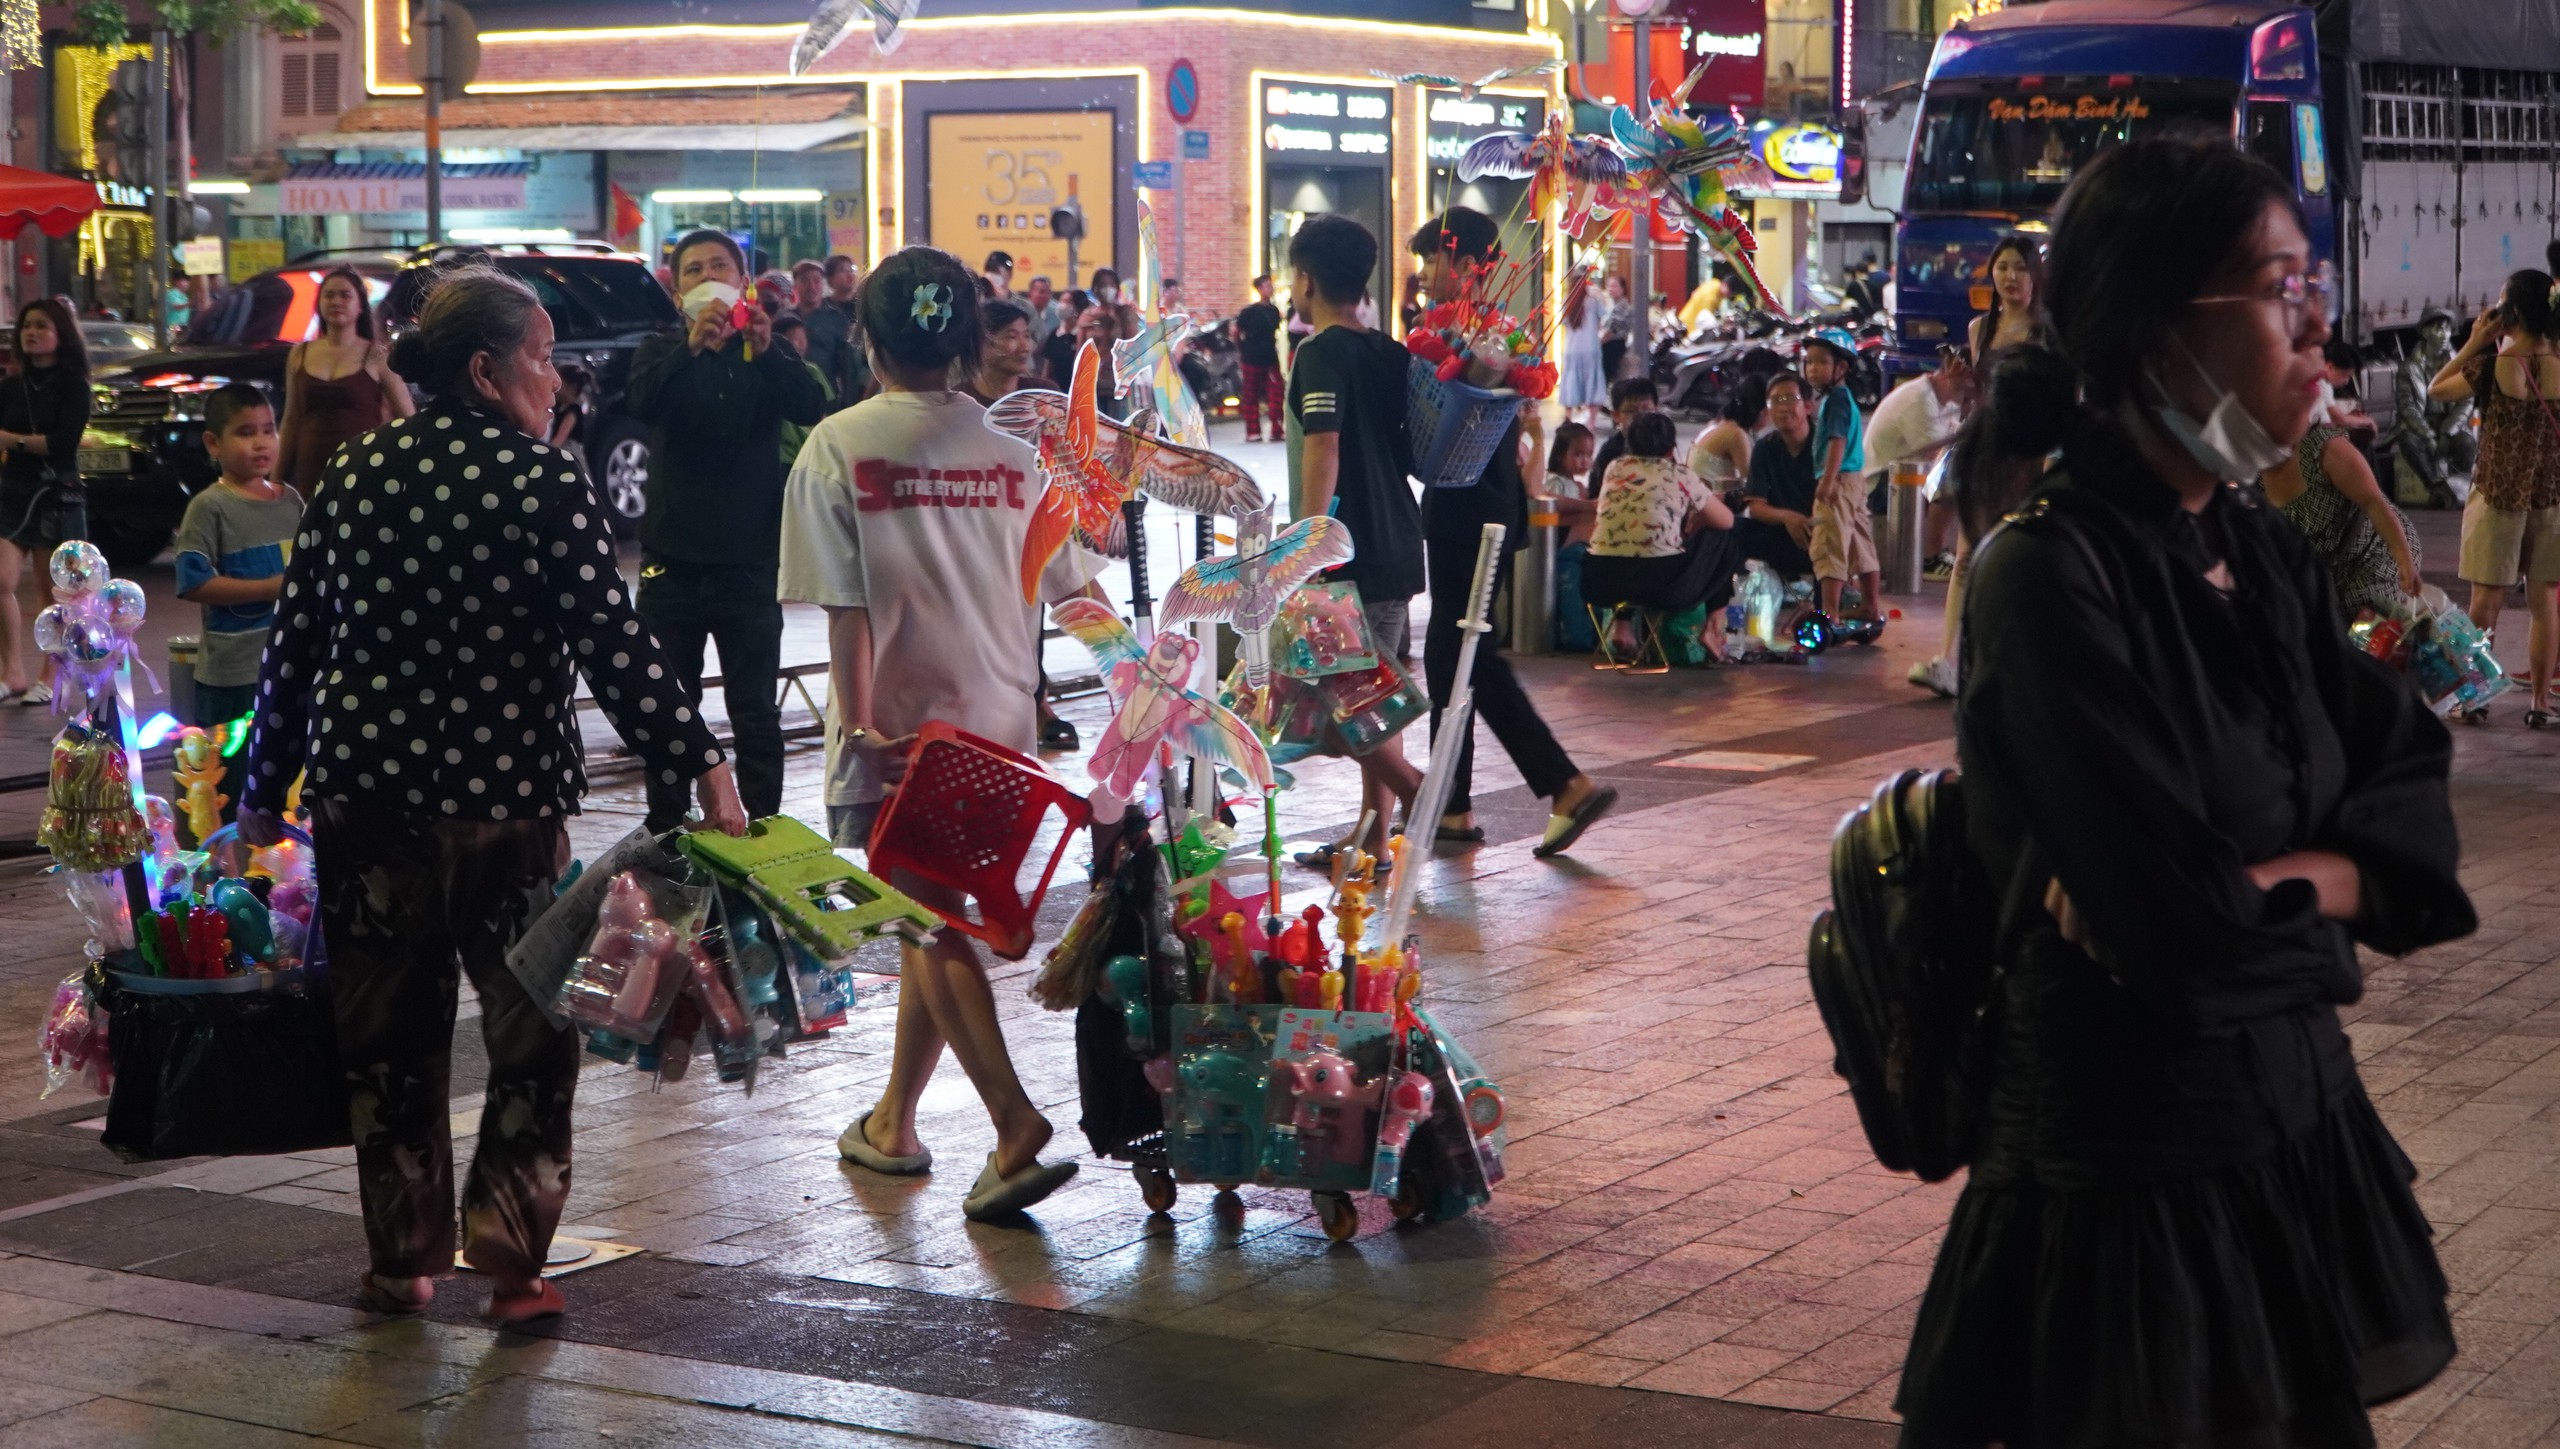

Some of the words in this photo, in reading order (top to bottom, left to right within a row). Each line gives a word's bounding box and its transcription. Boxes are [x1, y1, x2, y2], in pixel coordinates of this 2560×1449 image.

[287, 187, 352, 211] HOA
[833, 198, 858, 220] 97
[893, 479, 998, 498] STREETWEAR
